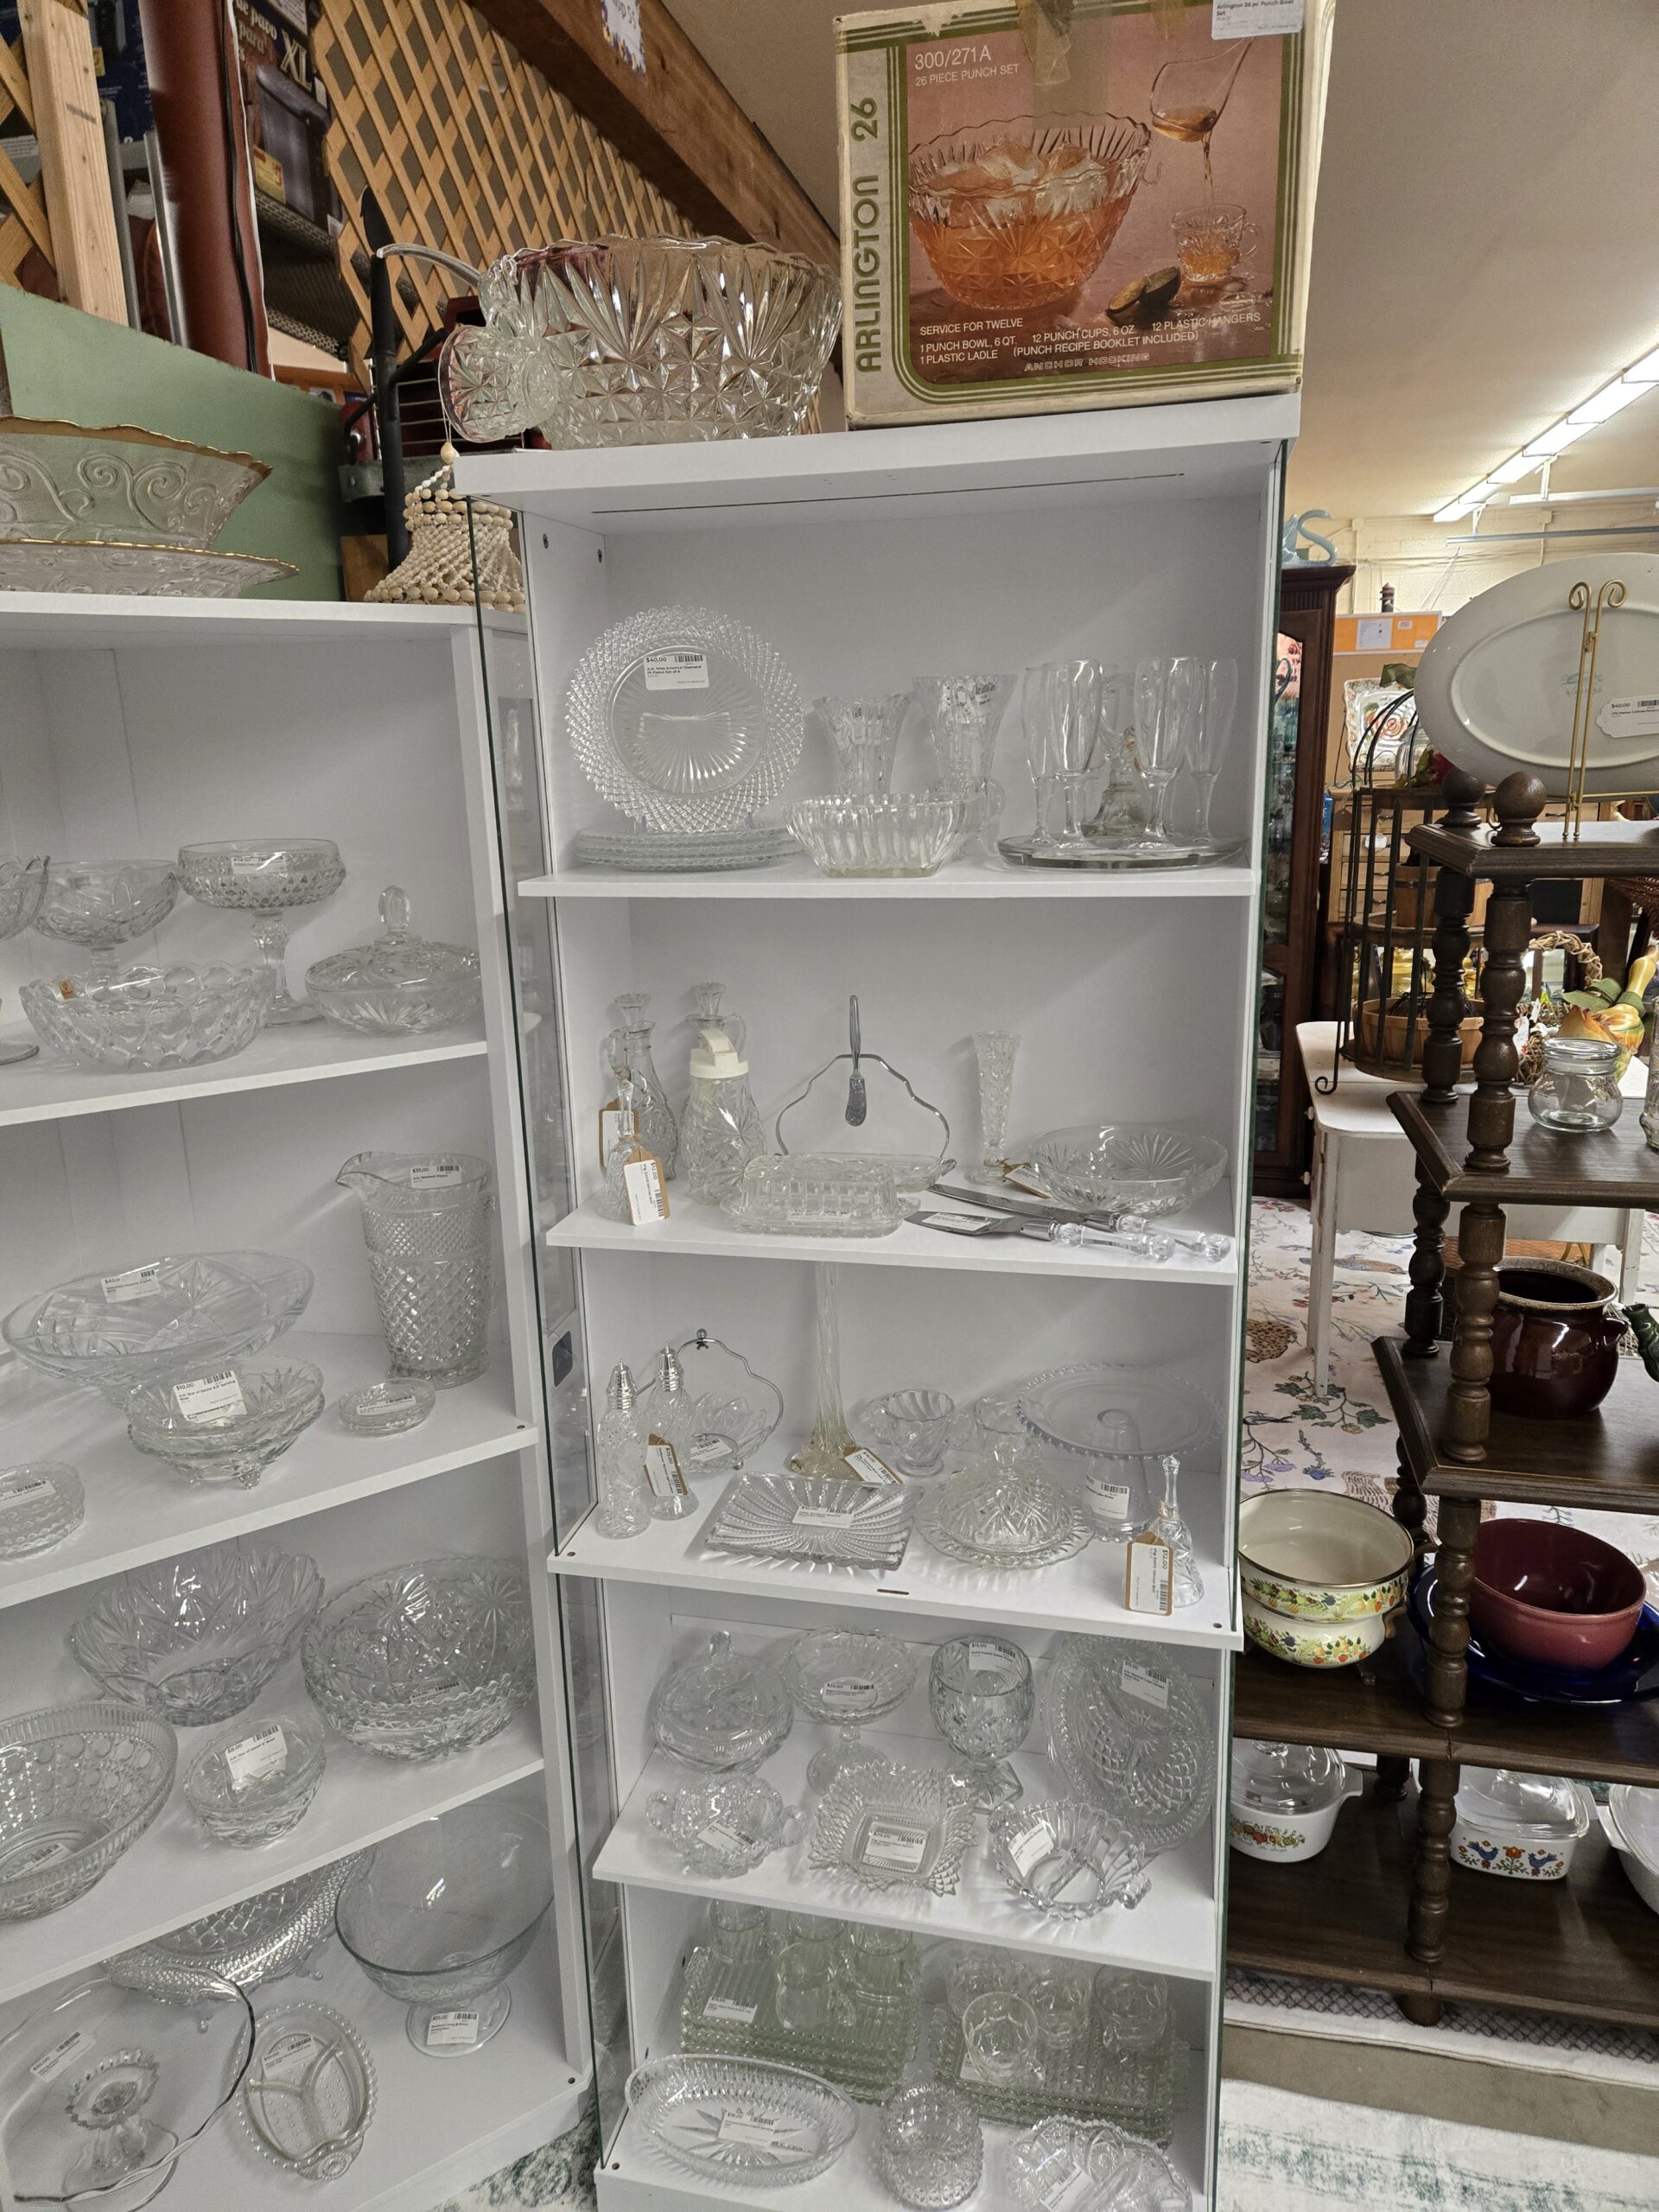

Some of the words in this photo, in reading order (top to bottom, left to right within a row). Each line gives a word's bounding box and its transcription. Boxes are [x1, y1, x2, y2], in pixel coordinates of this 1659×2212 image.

[280, 27, 312, 92] XL
[915, 45, 991, 70] 300/271A
[916, 76, 928, 86] 26
[930, 72, 957, 84] PIECE
[961, 67, 997, 80] PUNCH
[1000, 63, 1020, 74] SET
[849, 97, 878, 143] 26
[919, 323, 961, 336] SERVICE
[963, 321, 983, 333] FOR
[986, 318, 1023, 330] TWELVE
[1152, 322, 1162, 332] 12
[1164, 317, 1206, 331] PLASTIC
[1209, 312, 1262, 327] HANGERS
[1032, 334, 1041, 343] 12
[1043, 329, 1078, 342] PUNCH
[1081, 327, 1111, 339] CUPS,
[1113, 327, 1119, 335] 6
[1121, 324, 1137, 334] OZ.
[926, 341, 960, 353] PUNCH
[962, 339, 993, 350] BOWL,
[1002, 335, 1018, 346] QT.
[1014, 345, 1052, 358] (PUNCH
[1054, 341, 1091, 353] RECIPE
[1094, 336, 1140, 349] BOOKLET
[1142, 331, 1199, 346] INCLUDED)
[926, 352, 965, 365] PLASTIC
[968, 349, 998, 361] LADLE
[1024, 359, 1084, 372] ANCHOR
[650, 1161, 658, 1180] $12.00
[665, 1447, 674, 1465] $25.00
[226, 1744, 244, 1754] $8.00
